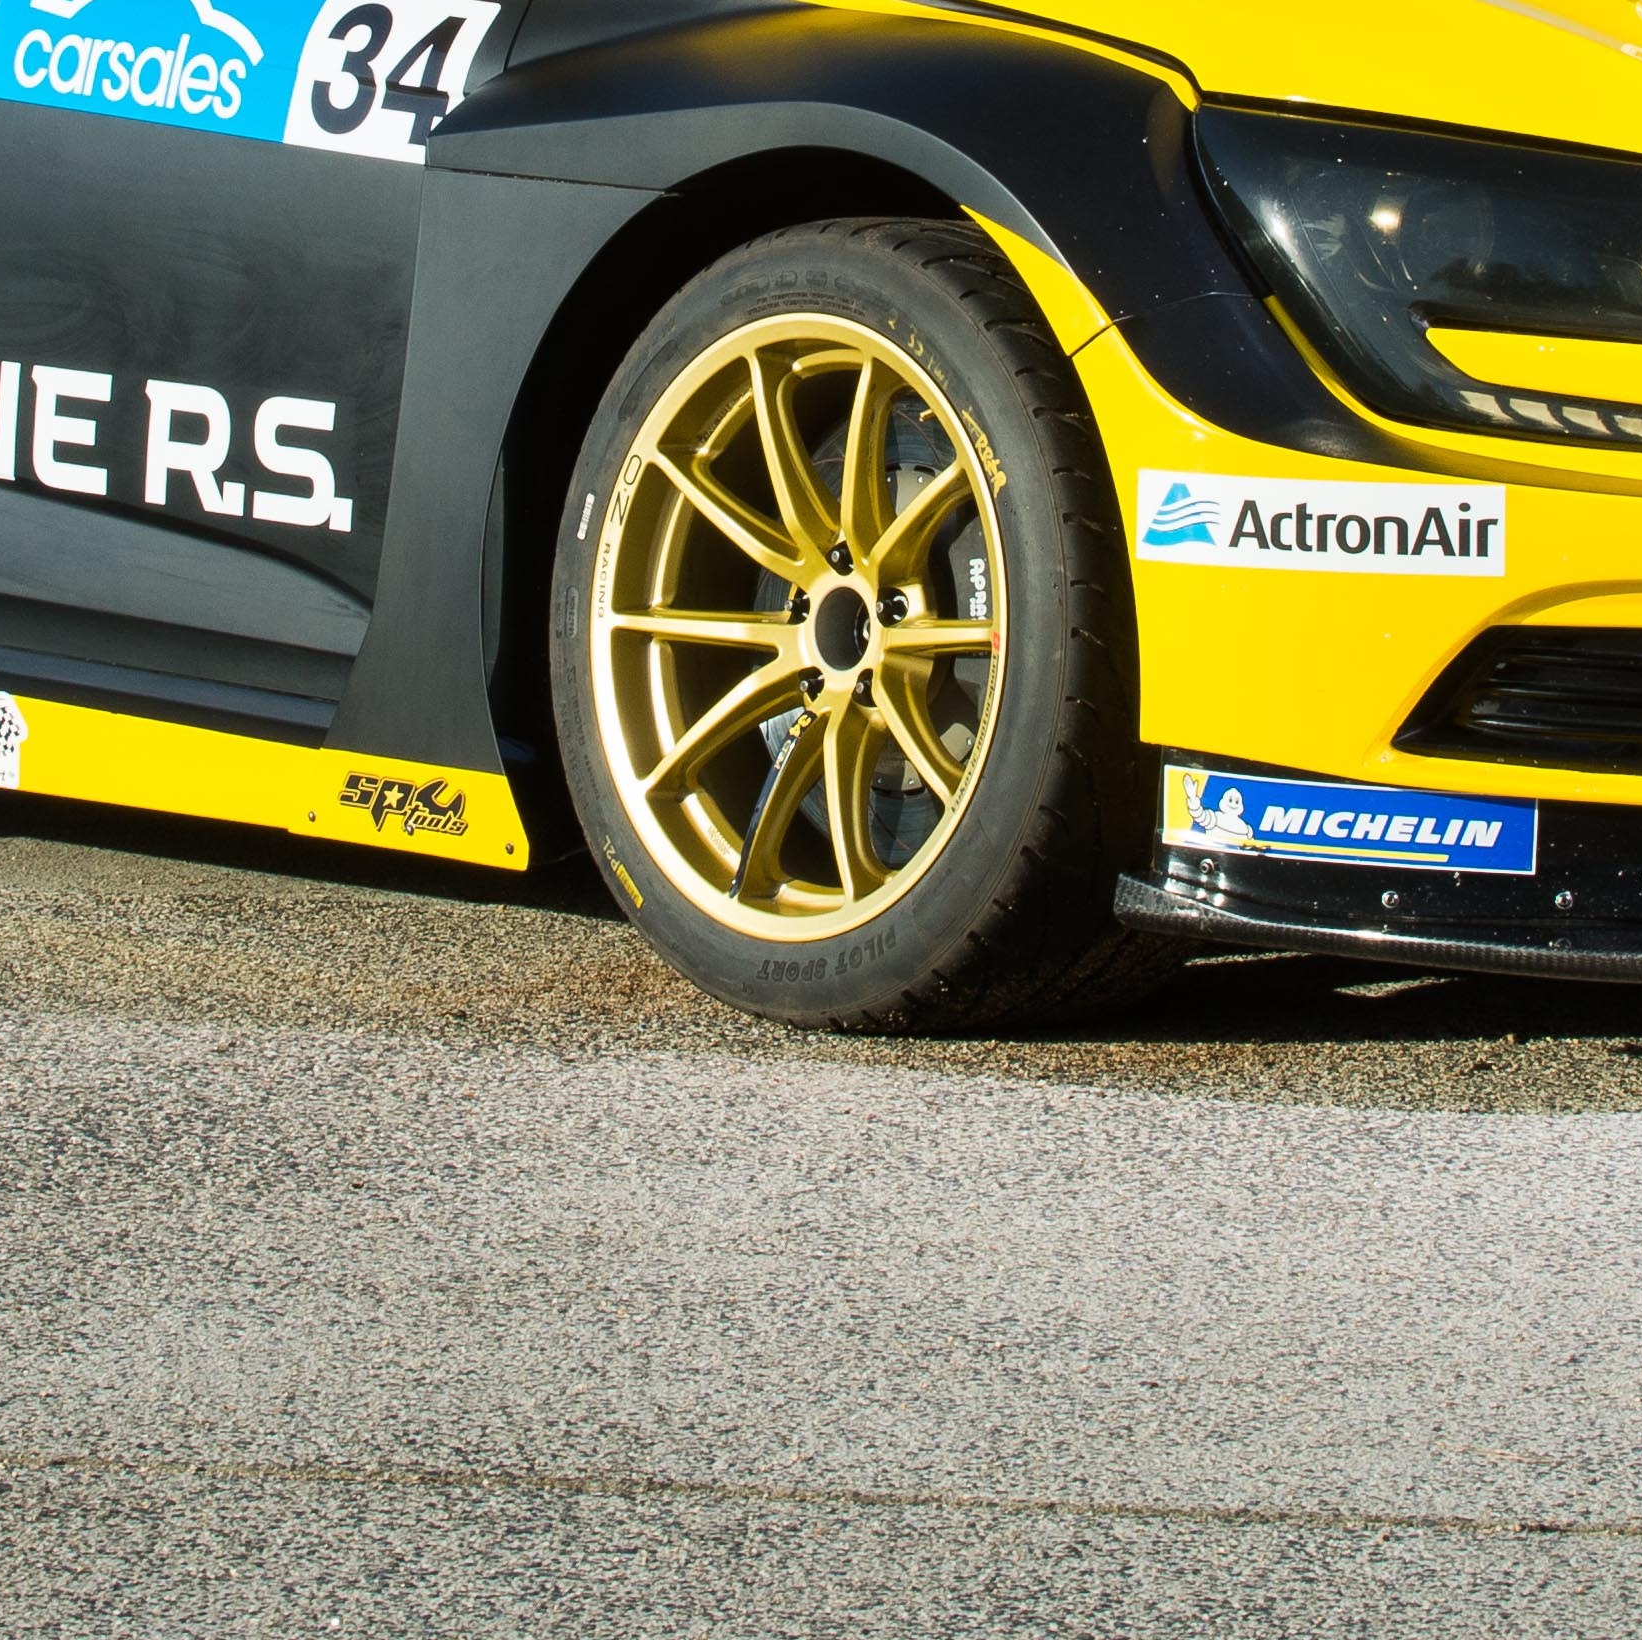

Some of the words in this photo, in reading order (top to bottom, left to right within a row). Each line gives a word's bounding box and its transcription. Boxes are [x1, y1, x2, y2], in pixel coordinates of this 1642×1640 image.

[13, 28, 248, 120] carsales
[311, 3, 467, 145] 34
[1228, 499, 1499, 558] ActronAir
[1259, 805, 1503, 848] MICHELIN
[756, 957, 828, 982] SPORT
